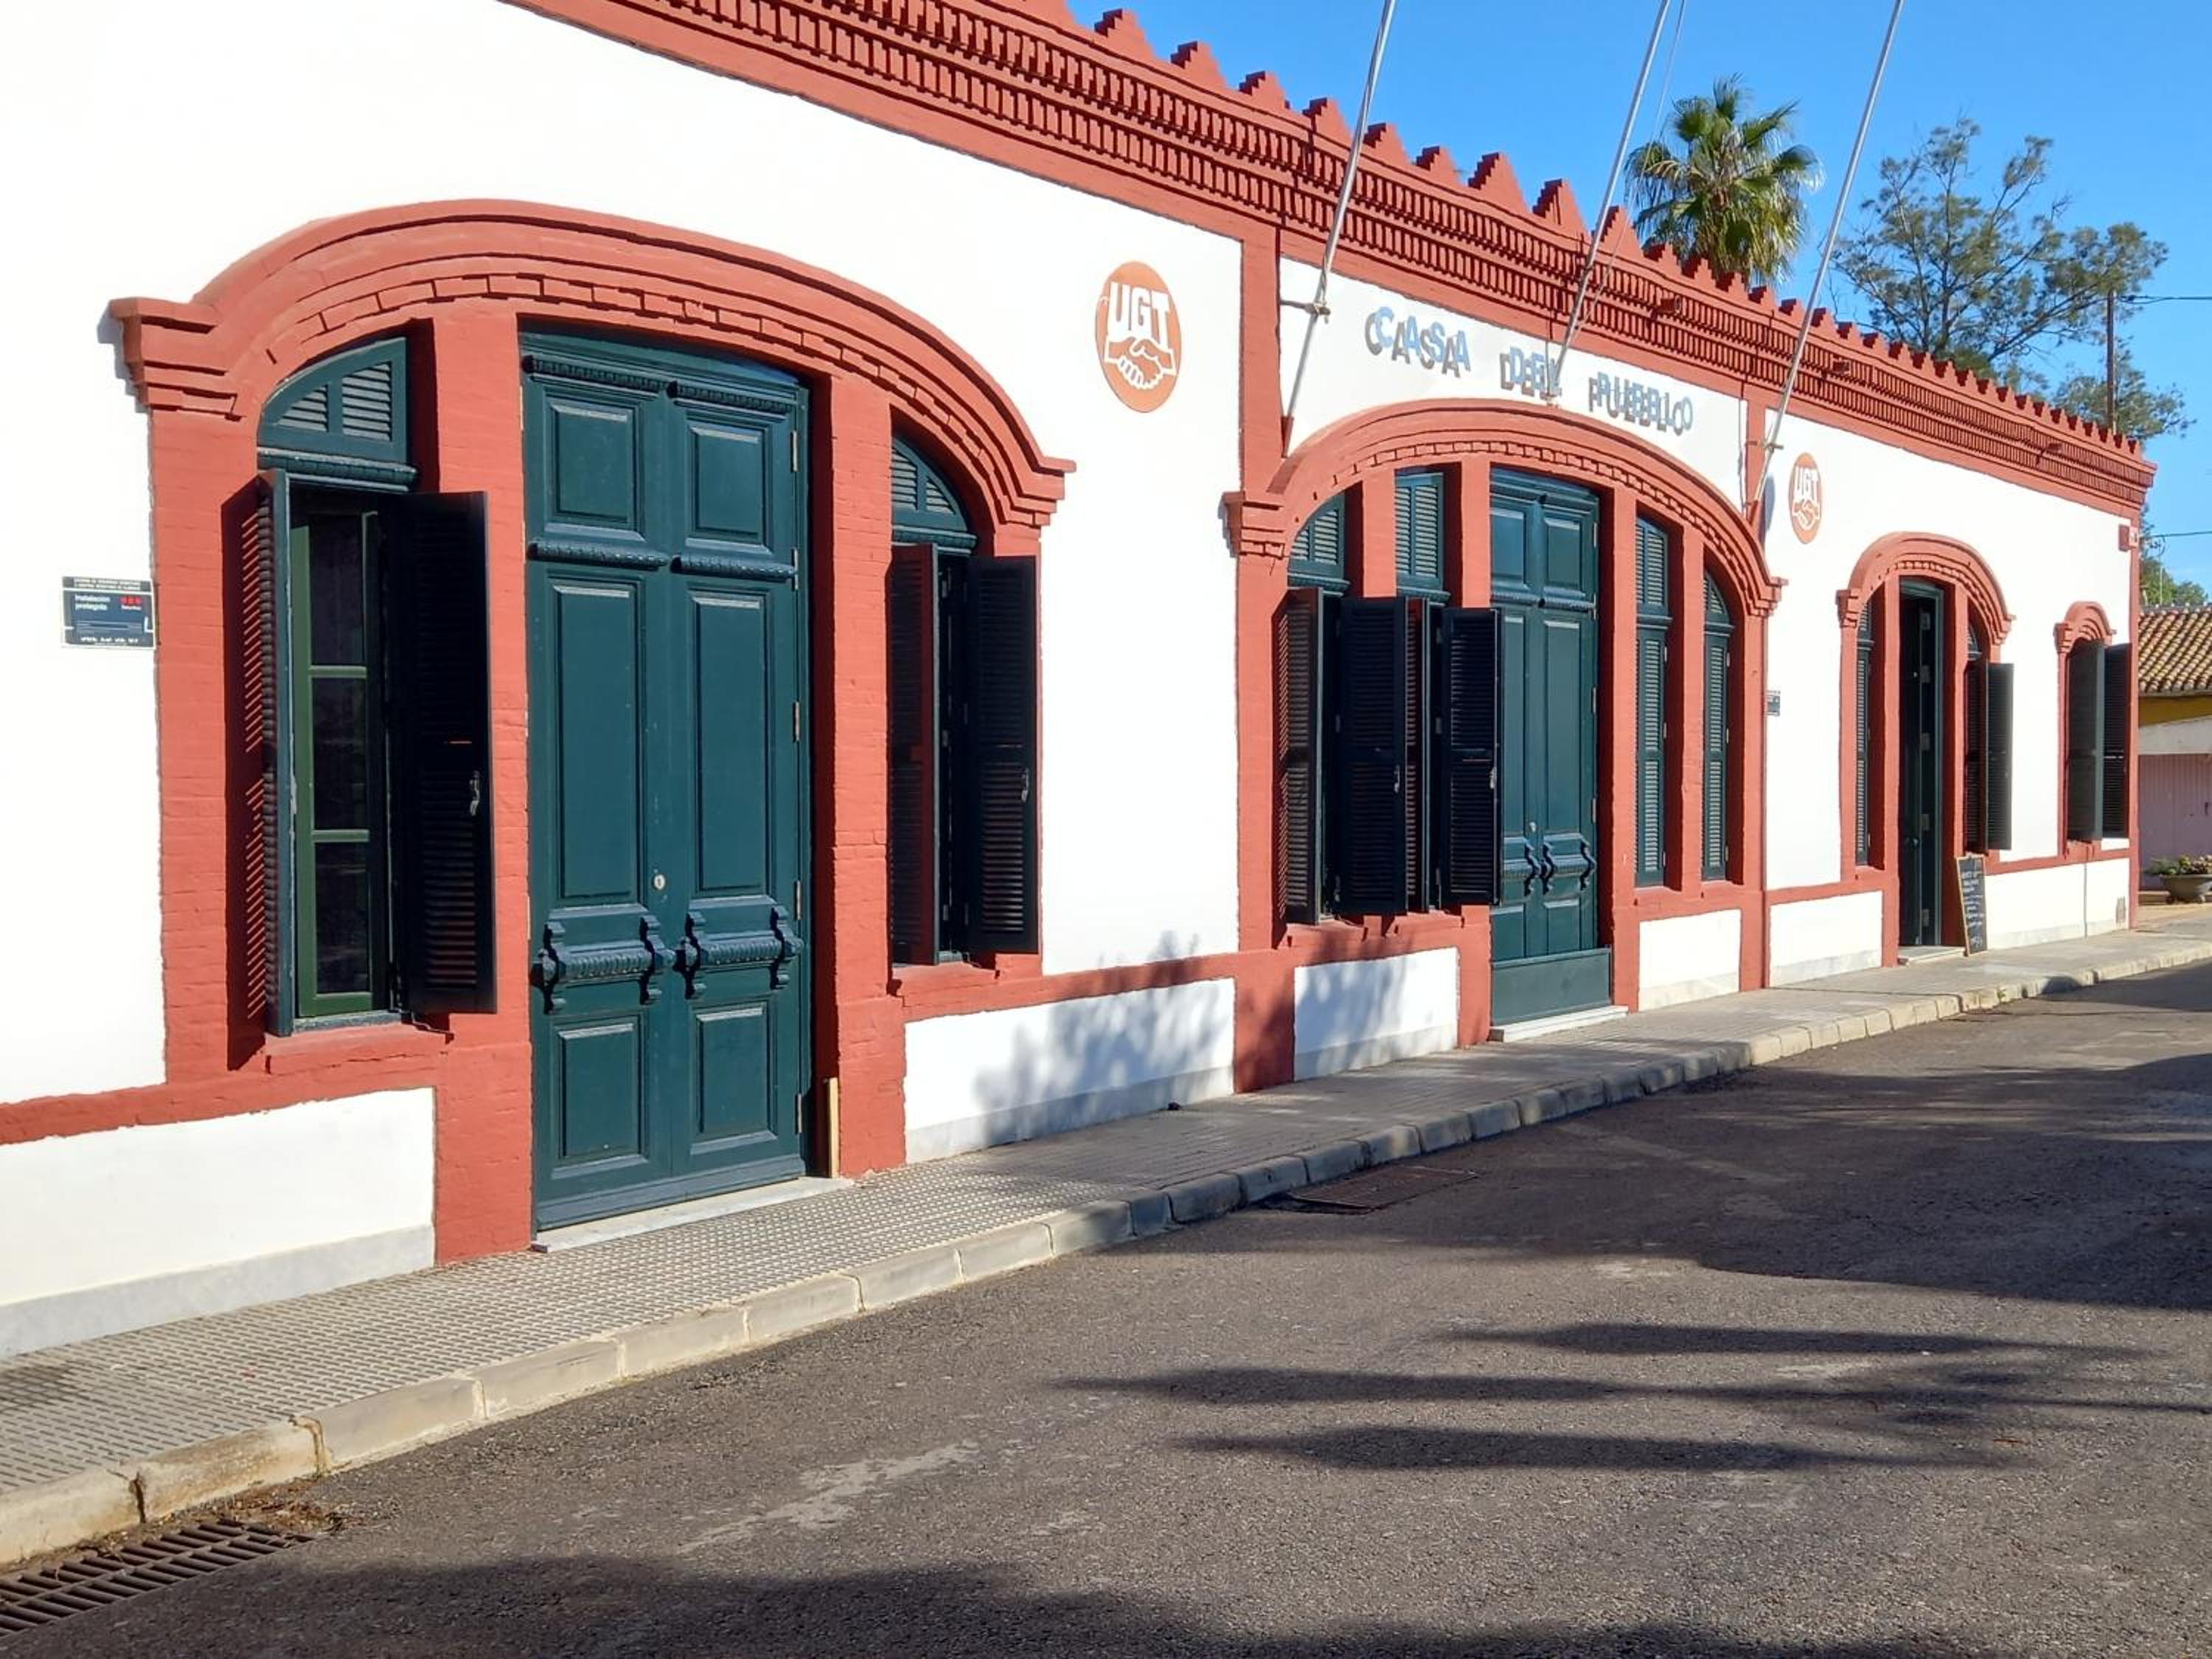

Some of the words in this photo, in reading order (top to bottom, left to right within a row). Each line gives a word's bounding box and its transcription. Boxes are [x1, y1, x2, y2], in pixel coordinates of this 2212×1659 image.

[1107, 282, 1171, 349] UGT
[1374, 307, 1471, 372] CASA
[1509, 347, 1562, 396] DEL
[1597, 372, 1694, 431] PUEBLO
[1794, 465, 1818, 502] UGT
